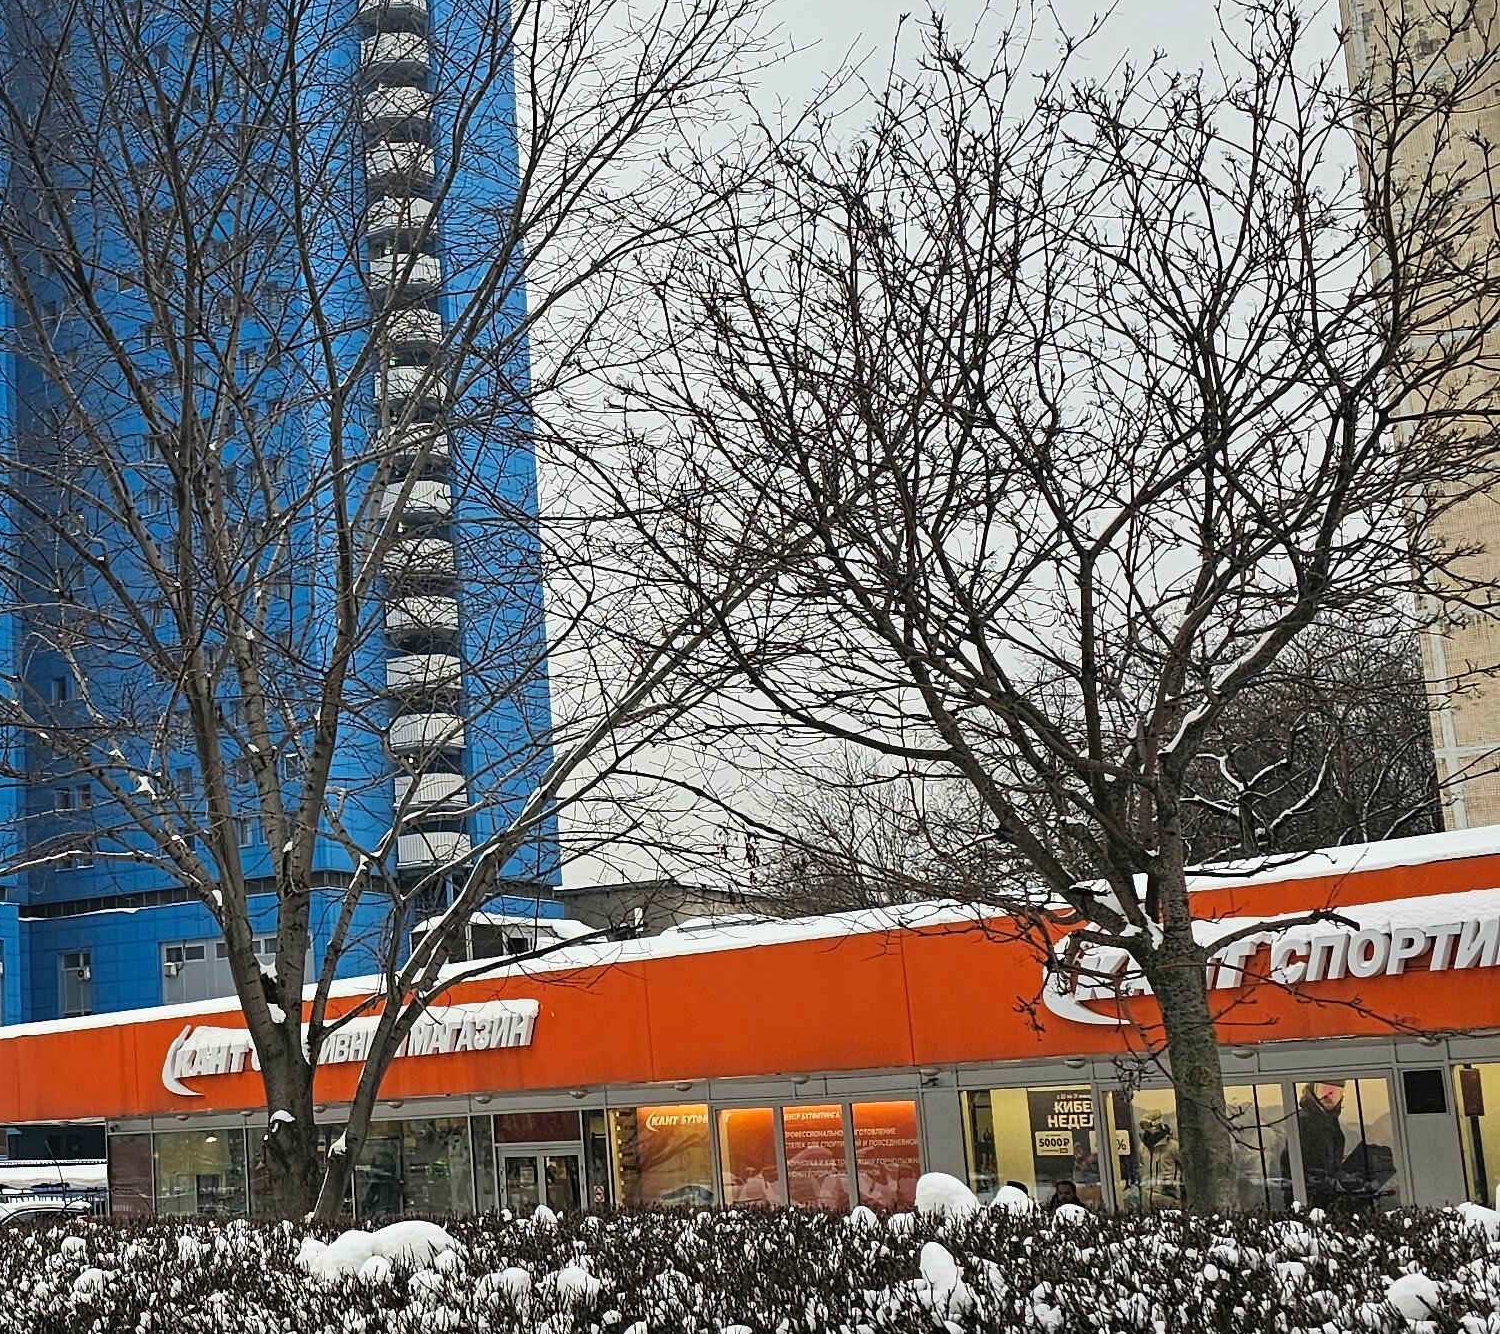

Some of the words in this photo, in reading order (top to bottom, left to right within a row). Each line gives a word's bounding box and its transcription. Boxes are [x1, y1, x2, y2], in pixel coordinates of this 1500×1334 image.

[1271, 917, 1500, 984] СПОРТИ
[174, 1041, 252, 1078] КАНТ
[408, 1012, 535, 1057] МАГАЗИН
[1053, 1101, 1093, 1113] КИБЕ
[650, 1115, 679, 1126] КАНТ
[1047, 1114, 1094, 1129] НЕДЕЛ
